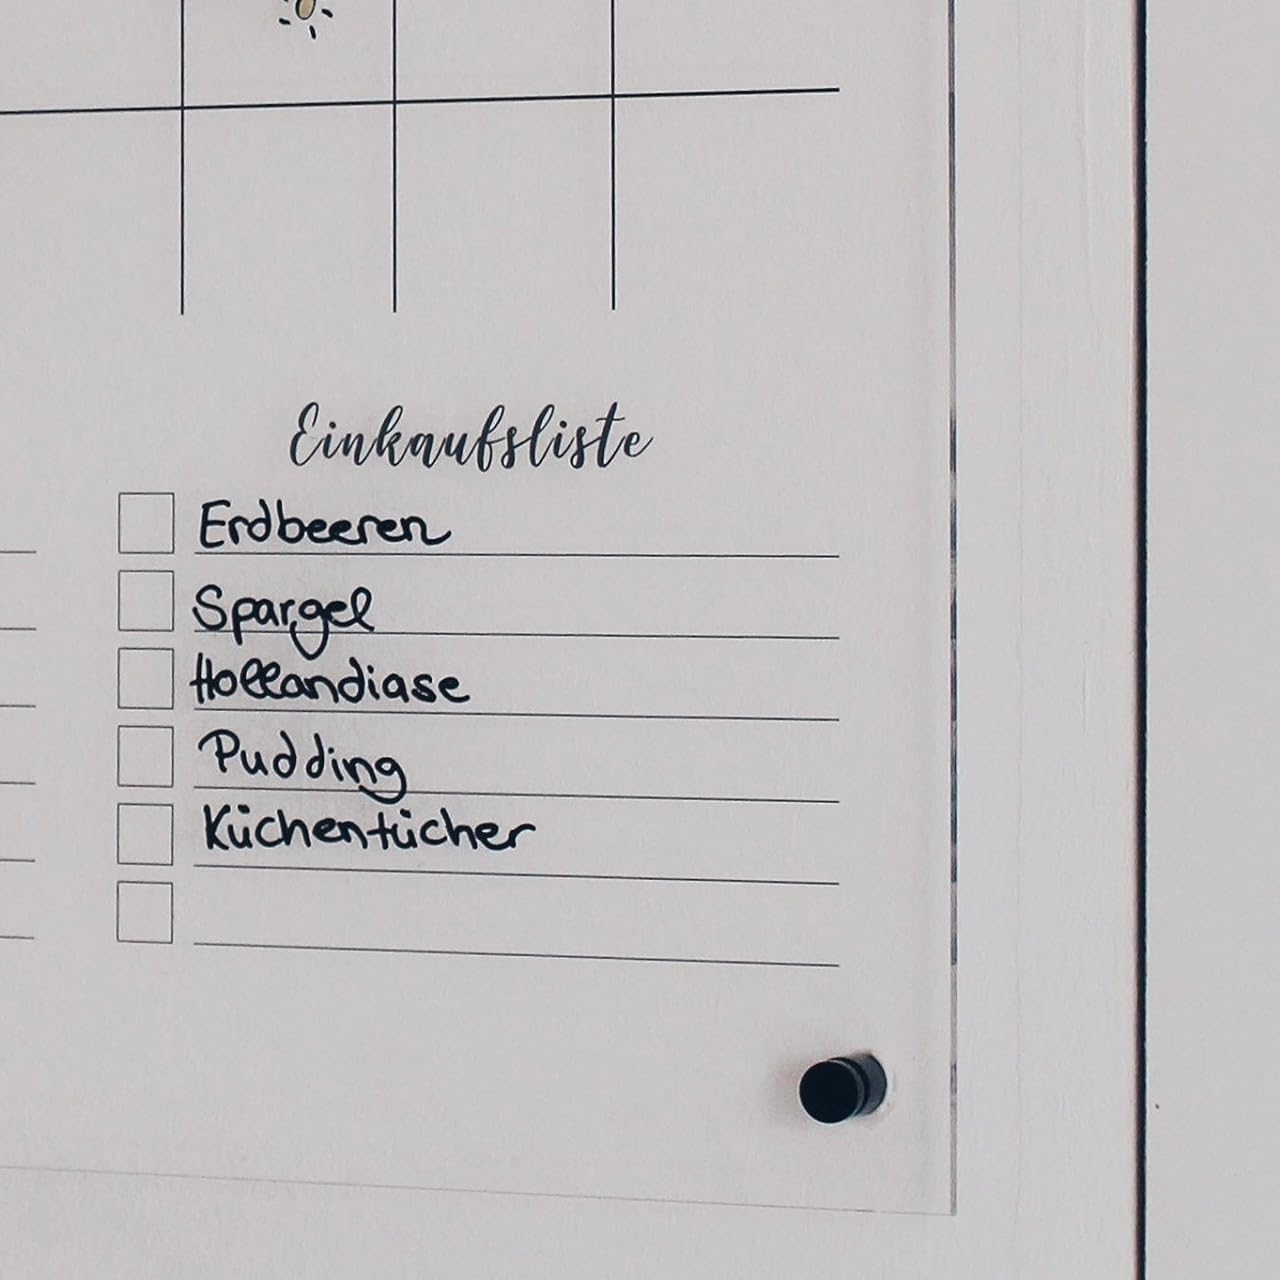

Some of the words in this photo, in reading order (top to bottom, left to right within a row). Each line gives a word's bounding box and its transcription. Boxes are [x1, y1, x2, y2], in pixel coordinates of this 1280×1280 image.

[289, 401, 654, 473] Einkaufsliste
[199, 498, 452, 549] Erdbeeren
[192, 584, 375, 661] Spargel
[189, 651, 471, 704] Hollandiase
[197, 728, 408, 804] Pudding
[203, 802, 537, 851] Küchentücher
